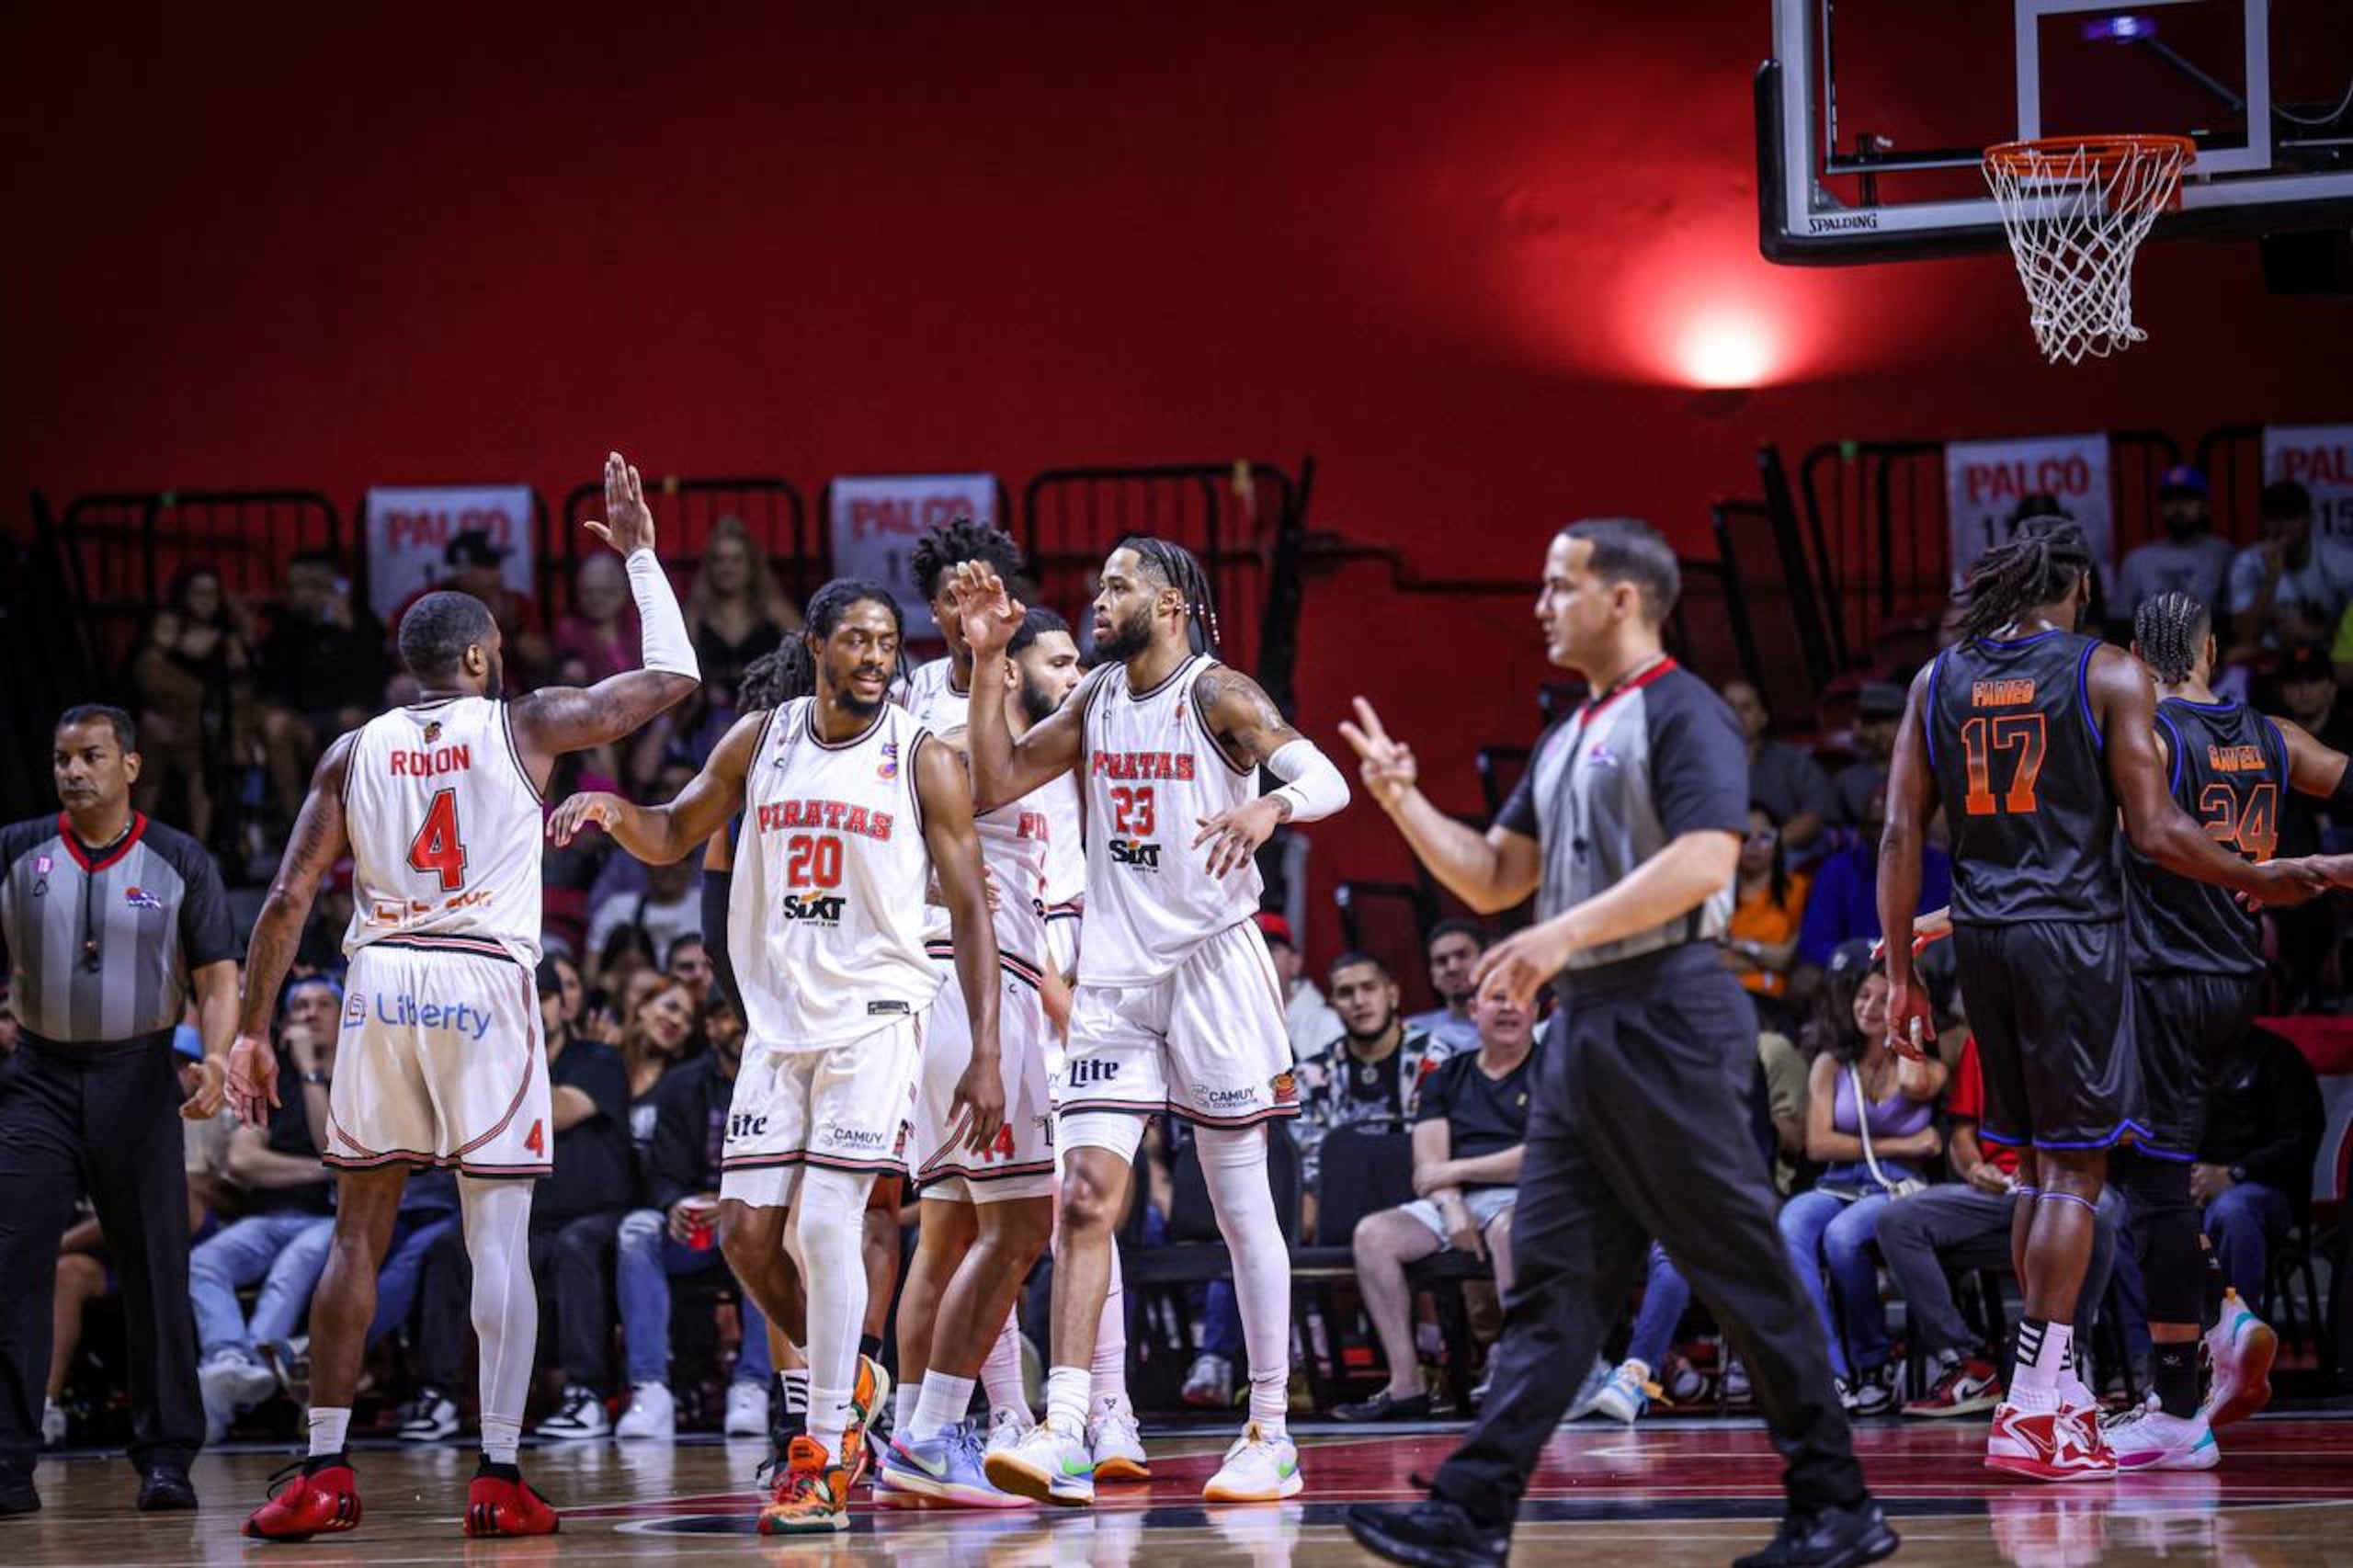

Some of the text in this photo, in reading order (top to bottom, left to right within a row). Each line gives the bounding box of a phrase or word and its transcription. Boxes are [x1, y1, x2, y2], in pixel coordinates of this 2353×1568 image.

[1809, 213, 1877, 233] SPALDING
[1964, 453, 2089, 504] PALCO
[1961, 712, 2047, 816] 17
[757, 800, 894, 842] PIRATAS
[1110, 787, 1155, 836] 23
[2200, 783, 2279, 862] 24
[406, 787, 468, 892] 4
[788, 835, 844, 889] 20
[376, 992, 492, 1040] Liberty
[1069, 1058, 1120, 1088] Lite
[1209, 1086, 1256, 1102] CAMUY
[524, 1119, 544, 1158] 4
[833, 1128, 884, 1144] CAMUY
